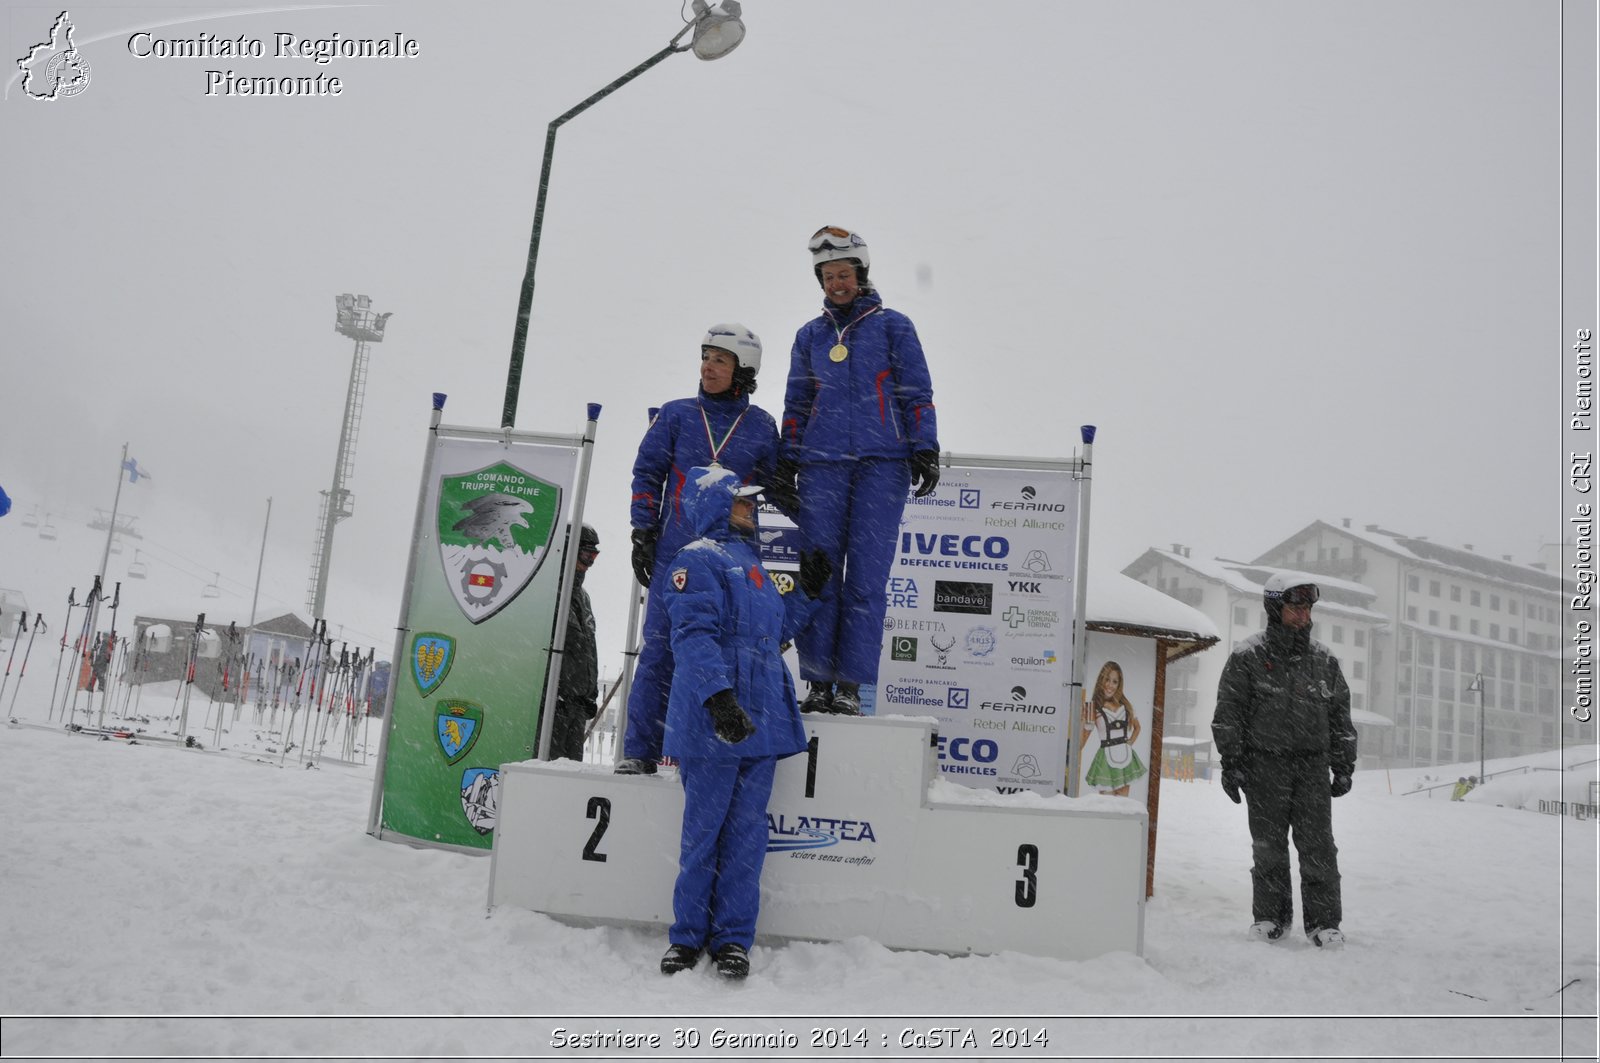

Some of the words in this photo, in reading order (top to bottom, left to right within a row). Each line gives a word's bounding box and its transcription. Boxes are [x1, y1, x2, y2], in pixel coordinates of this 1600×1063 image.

[476, 472, 526, 485] COMANDO
[460, 481, 496, 491] TRUPPE
[503, 485, 540, 497] ALPINE
[905, 497, 956, 507] altellinese
[990, 501, 1066, 513] FERRINO
[984, 516, 1017, 528] Rebel
[1022, 518, 1065, 531] Alliance
[760, 545, 798, 555] FEL
[901, 532, 1010, 559] IVECO
[900, 558, 951, 568] DEFENCE
[953, 560, 1009, 571] VEHICLES
[888, 577, 918, 593] EA
[1008, 581, 1042, 593] YKK
[937, 594, 988, 607] bandavej
[1027, 609, 1058, 617] FARMACIE
[897, 620, 947, 632] BERETTA
[1027, 616, 1060, 624] COMUNALI
[1011, 656, 1046, 667] equilon
[898, 677, 924, 685] GRUPPO
[926, 679, 958, 687] BANCARIO
[886, 684, 924, 696] Credito
[885, 694, 944, 707] Valtellinese
[979, 702, 1056, 715] FERRINO
[973, 718, 1006, 731] Rebel
[1012, 721, 1056, 734] Alliance
[937, 737, 999, 763] ECO
[805, 736, 819, 798] 1
[941, 764, 997, 776] VEHICLES
[996, 786, 1031, 795] YK
[582, 796, 611, 863] 2
[766, 813, 876, 843] ALATTEA
[790, 851, 817, 860] sciare
[817, 854, 844, 863] senza
[844, 855, 876, 867] confini
[1015, 844, 1039, 908] 3
